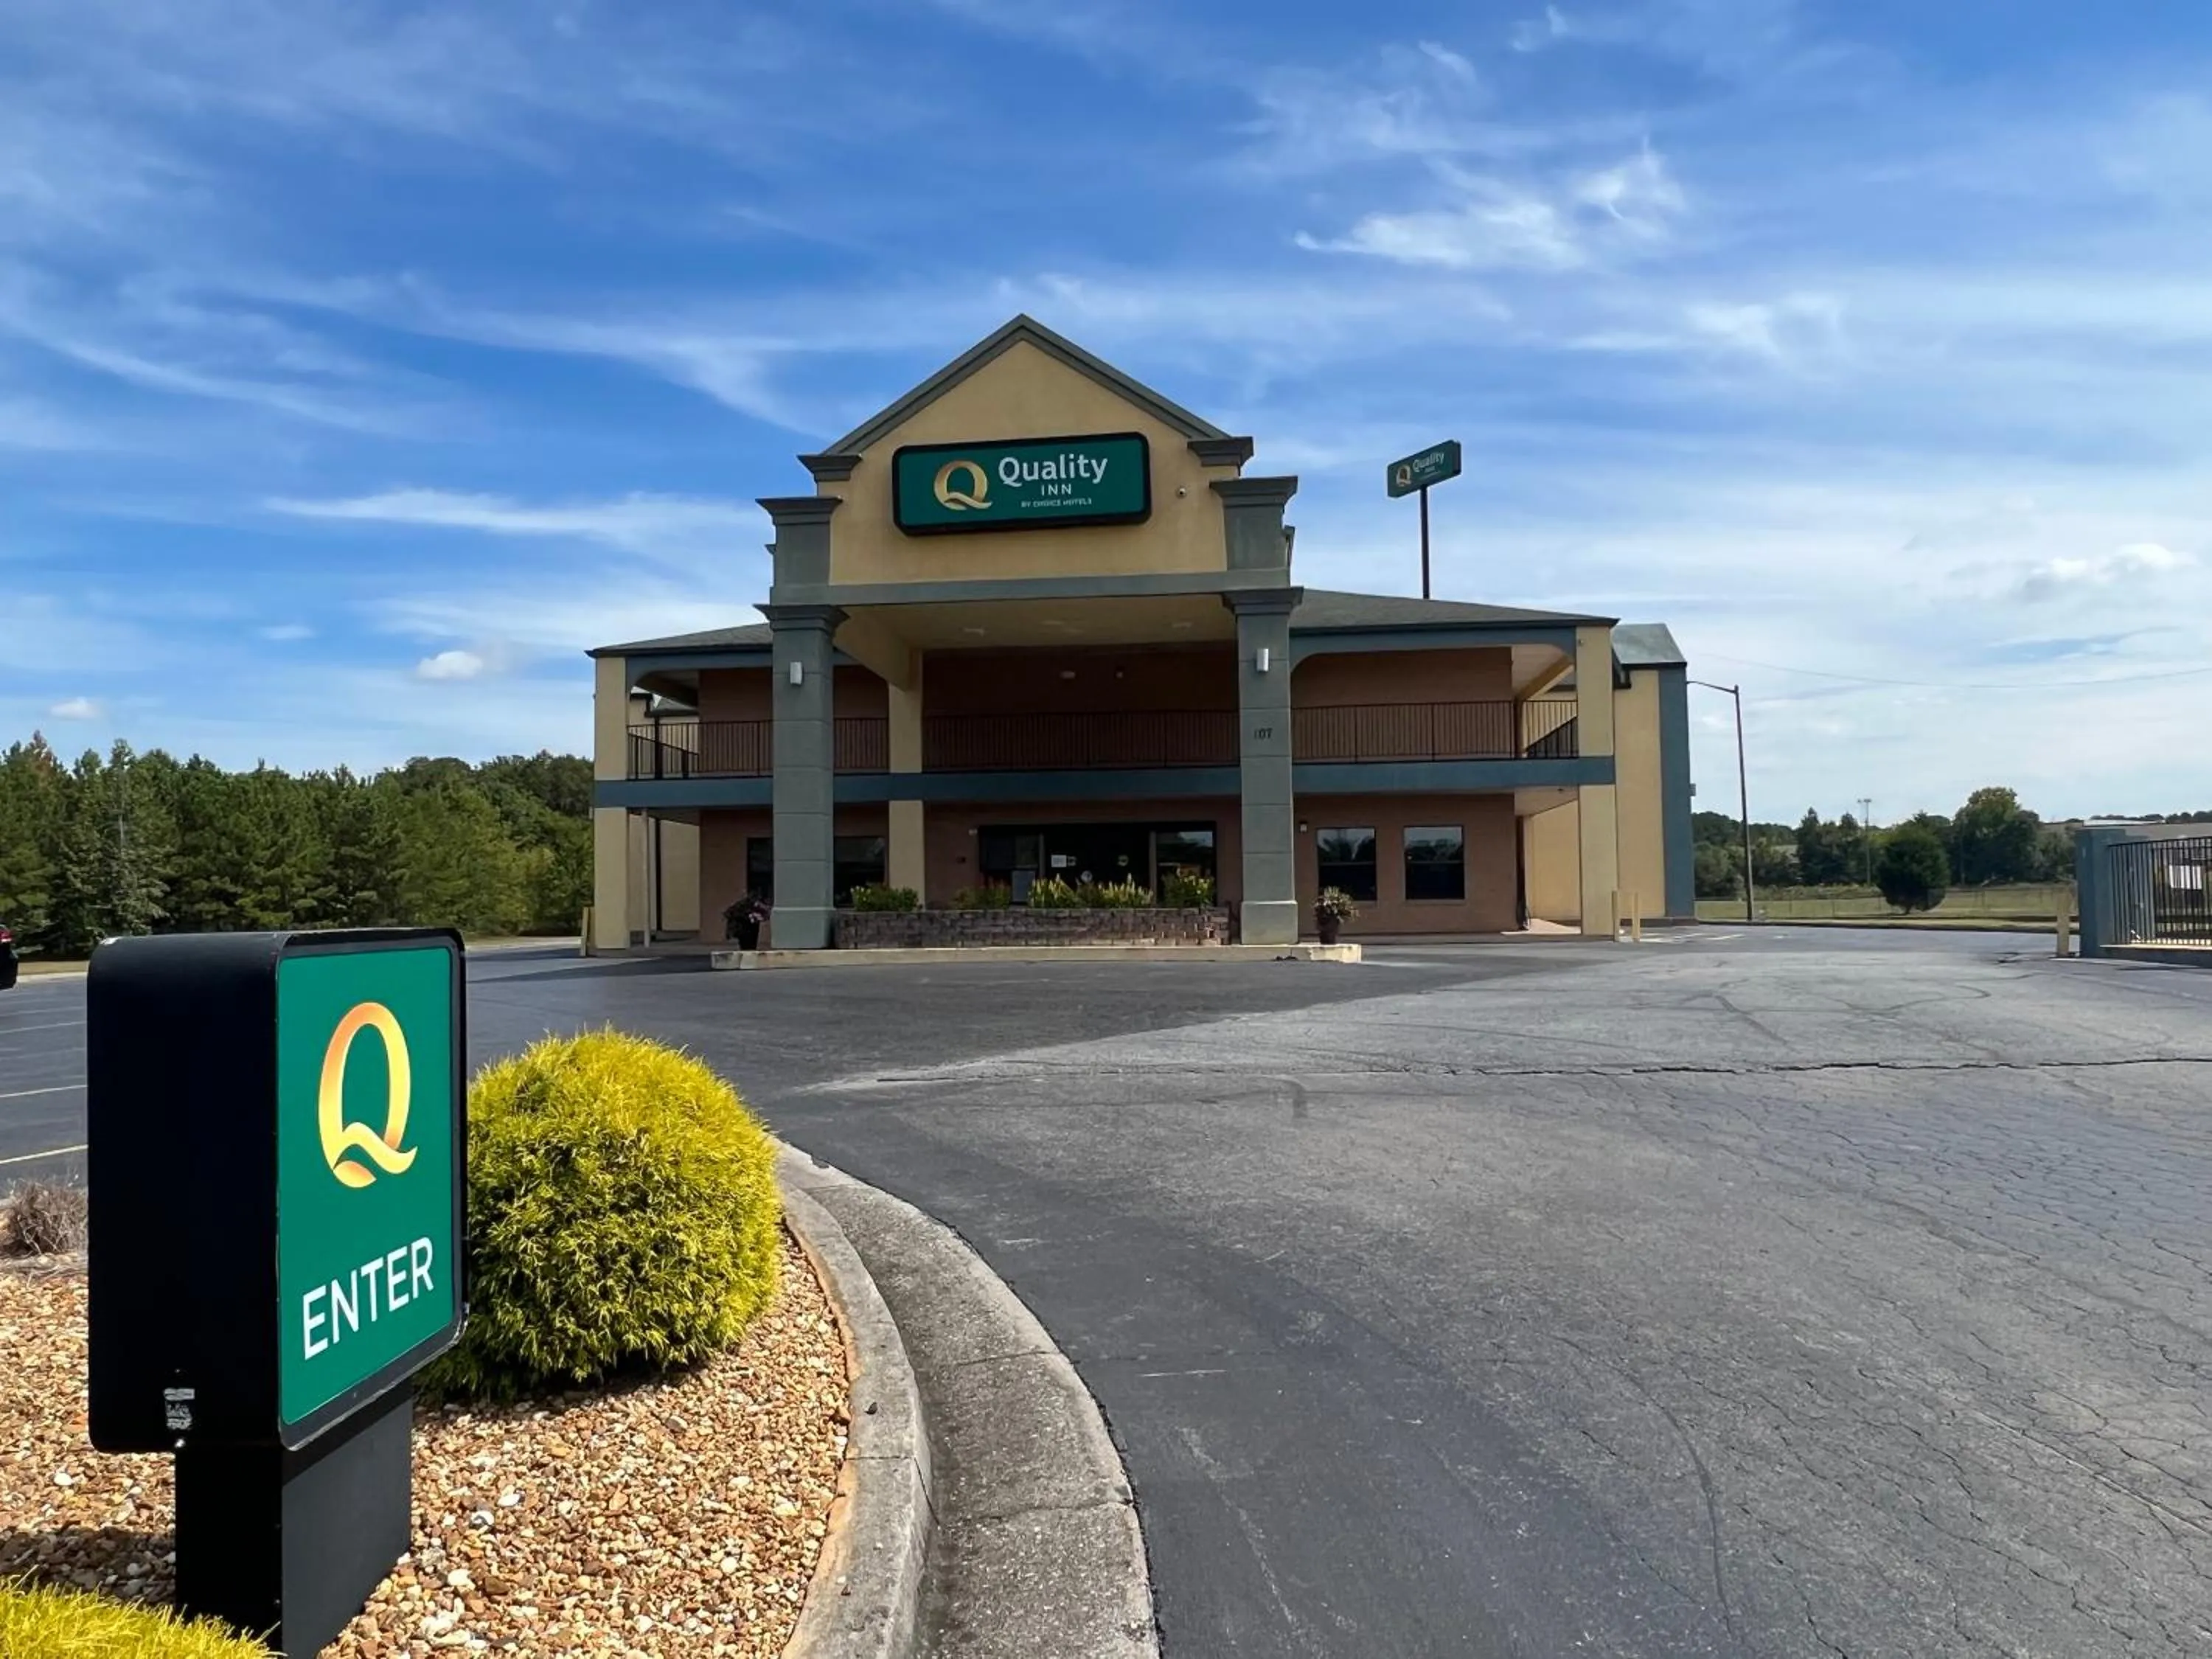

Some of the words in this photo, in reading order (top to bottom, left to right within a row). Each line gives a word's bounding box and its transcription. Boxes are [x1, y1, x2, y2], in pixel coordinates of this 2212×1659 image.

[998, 453, 1108, 487] Quality
[1413, 453, 1444, 473] Quality
[933, 460, 992, 510] Q
[1041, 484, 1072, 496] INN
[1254, 727, 1273, 740] 107
[319, 1001, 417, 1188] Q
[303, 1237, 434, 1360] ENTER
